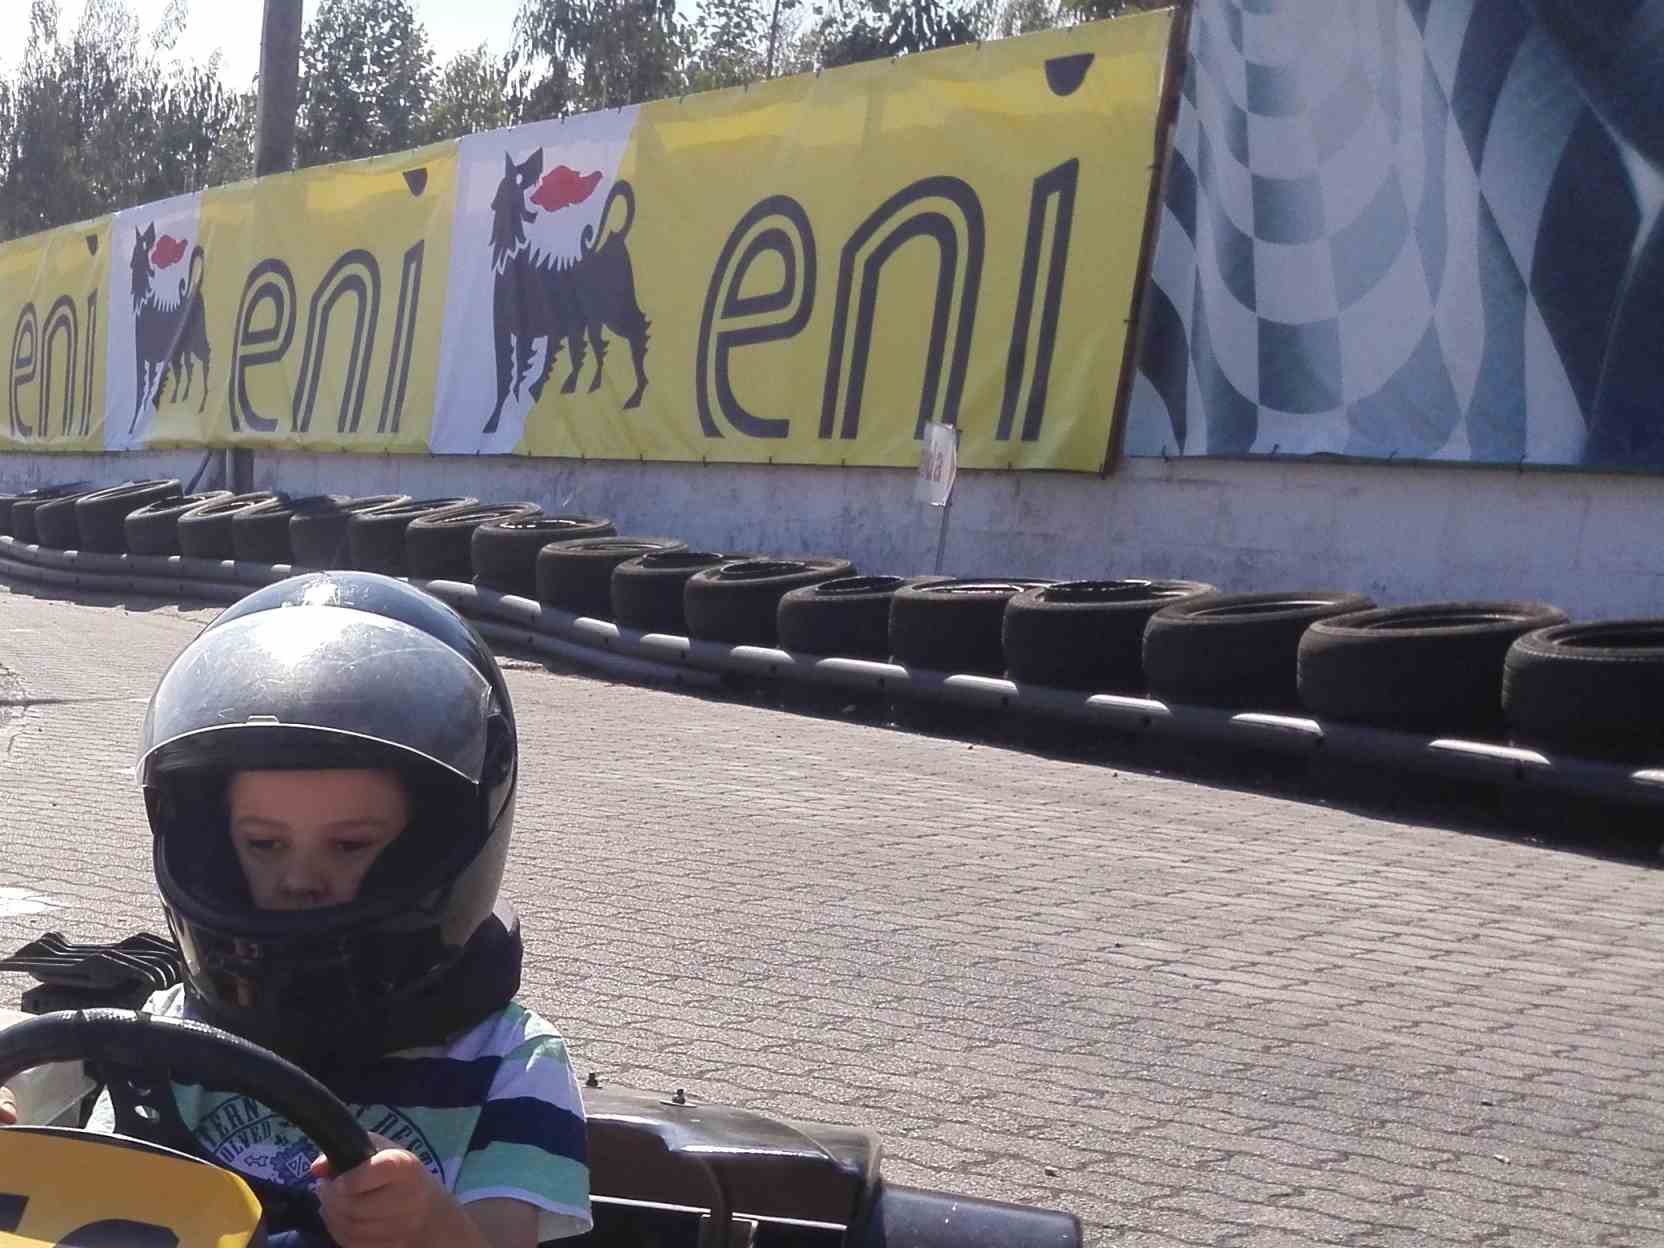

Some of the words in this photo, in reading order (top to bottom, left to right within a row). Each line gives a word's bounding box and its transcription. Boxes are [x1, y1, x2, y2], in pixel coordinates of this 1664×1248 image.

[8, 234, 99, 438] eni
[229, 168, 428, 434] eni
[695, 52, 1095, 442] eni
